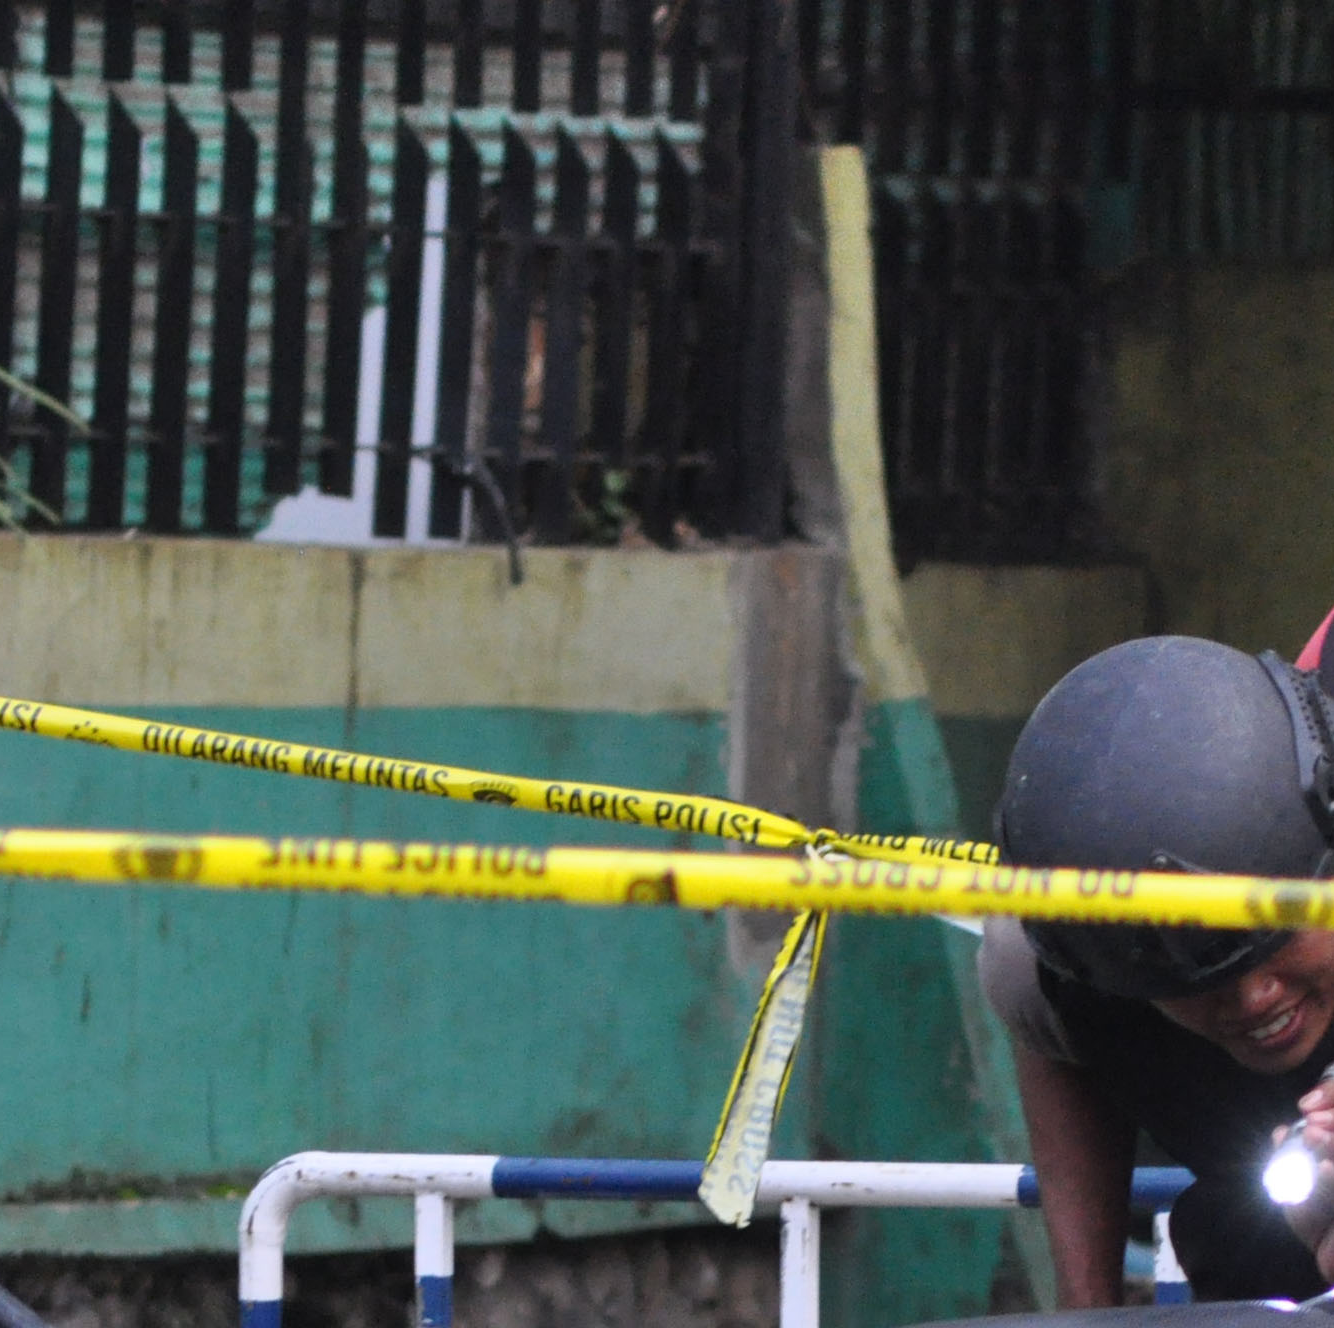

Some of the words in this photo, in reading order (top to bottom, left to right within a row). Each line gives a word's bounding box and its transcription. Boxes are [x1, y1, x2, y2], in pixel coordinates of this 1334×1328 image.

[142, 723, 291, 774] DILARANG
[302, 749, 449, 798] MELINTAS
[546, 785, 641, 825] GARIS
[655, 800, 761, 844] POLISI
